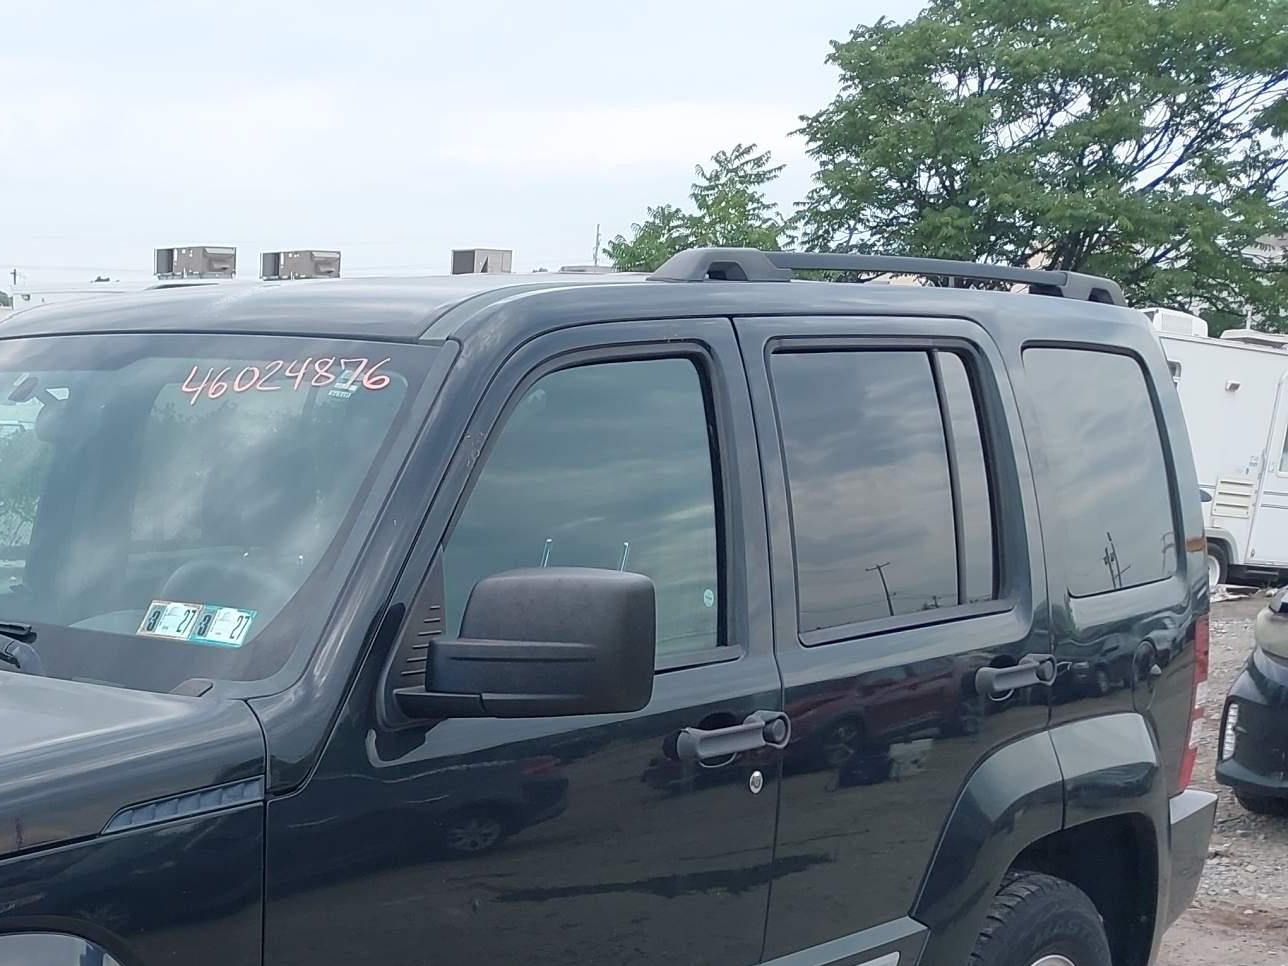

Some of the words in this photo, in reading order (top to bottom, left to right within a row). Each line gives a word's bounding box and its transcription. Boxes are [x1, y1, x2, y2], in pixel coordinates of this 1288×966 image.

[182, 357, 391, 405] 46024876
[176, 611, 197, 635] 27
[229, 615, 250, 640] 27
